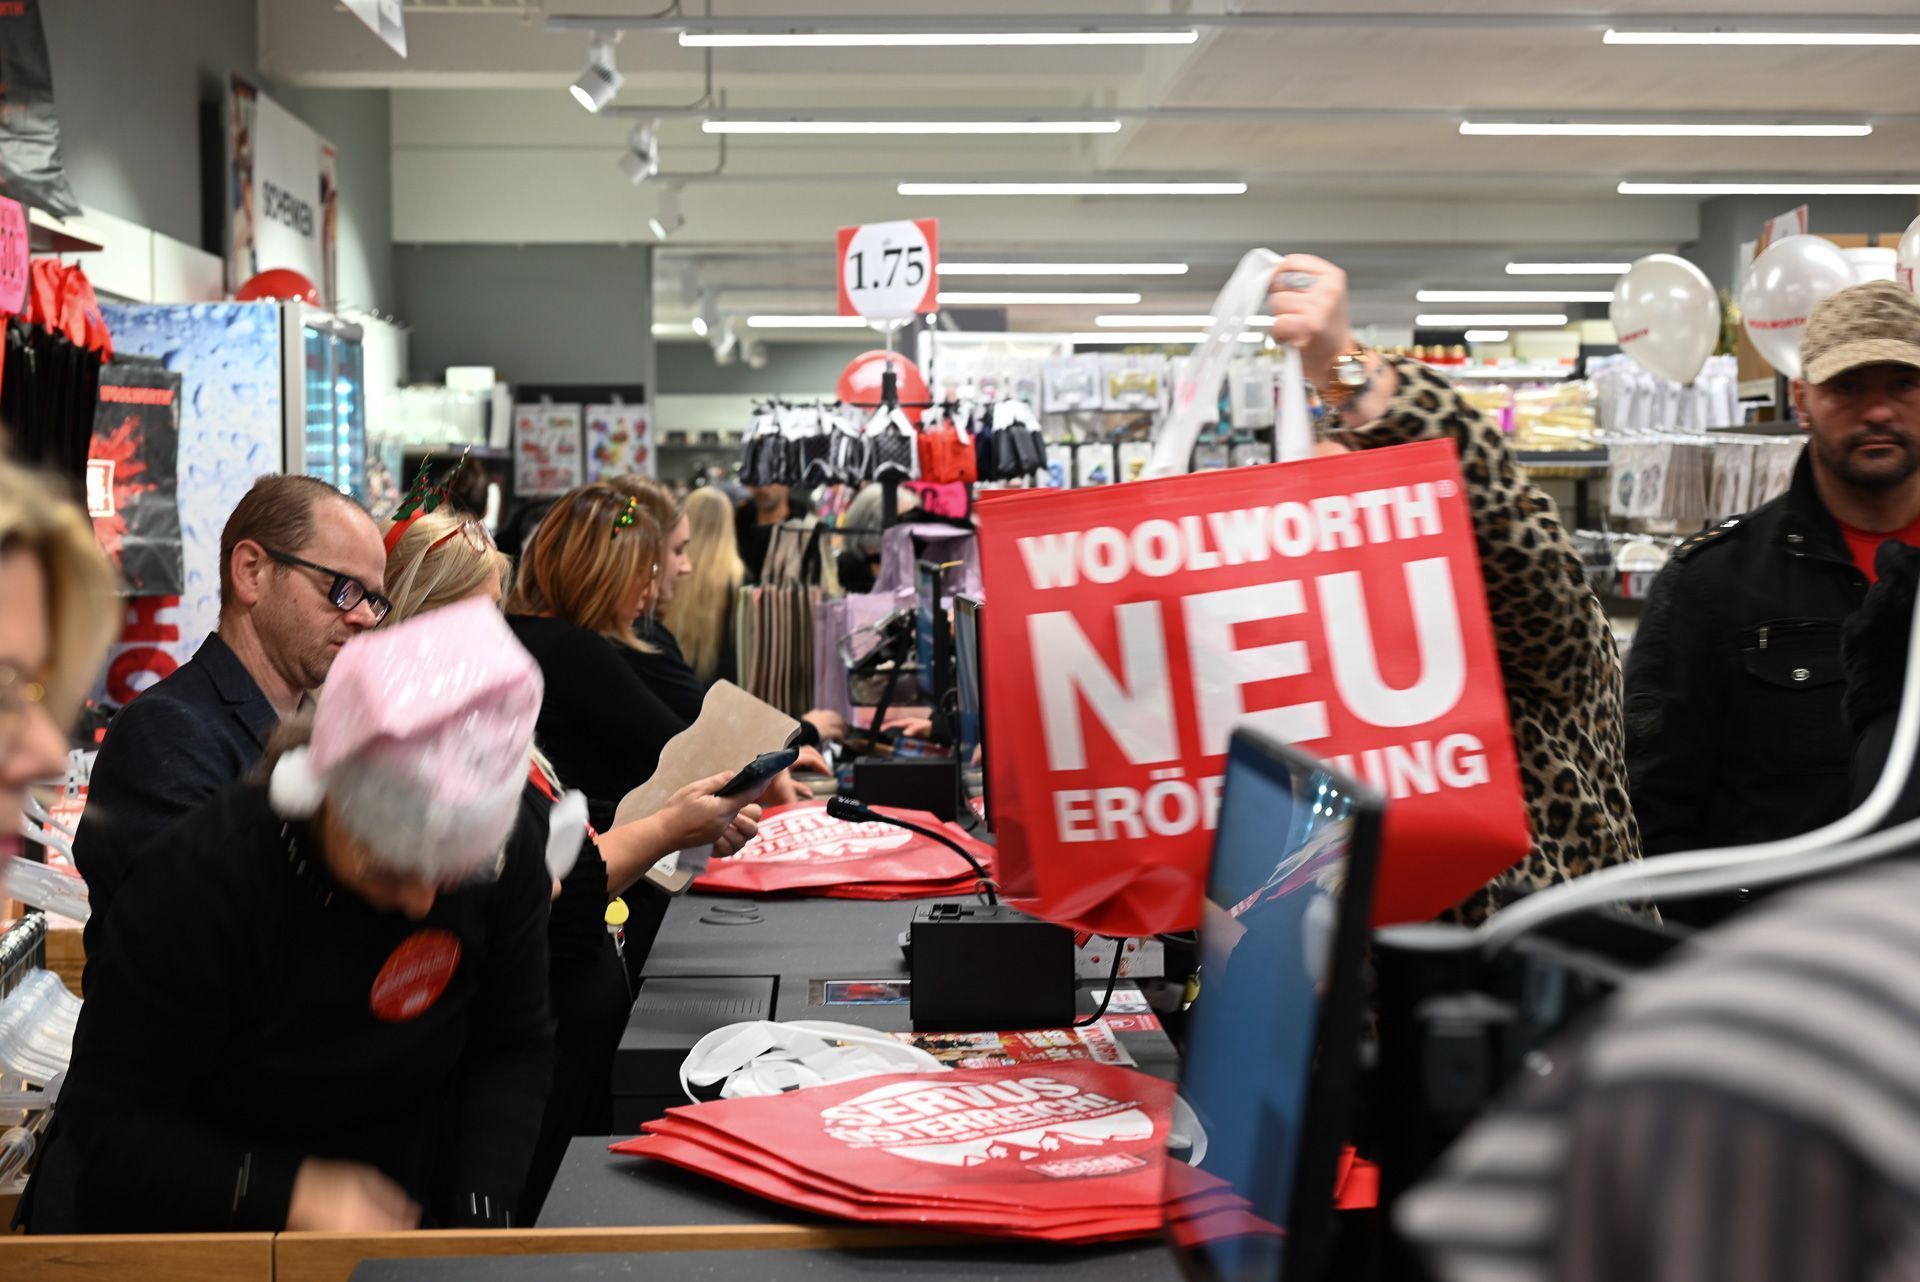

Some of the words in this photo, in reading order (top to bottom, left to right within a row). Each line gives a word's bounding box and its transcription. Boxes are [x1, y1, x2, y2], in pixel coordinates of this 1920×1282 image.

[849, 246, 924, 290] 1.75
[1026, 556, 1467, 771] NEU
[1053, 733, 1491, 843] ERÖFUNG
[820, 1077, 1079, 1128] SERVUS
